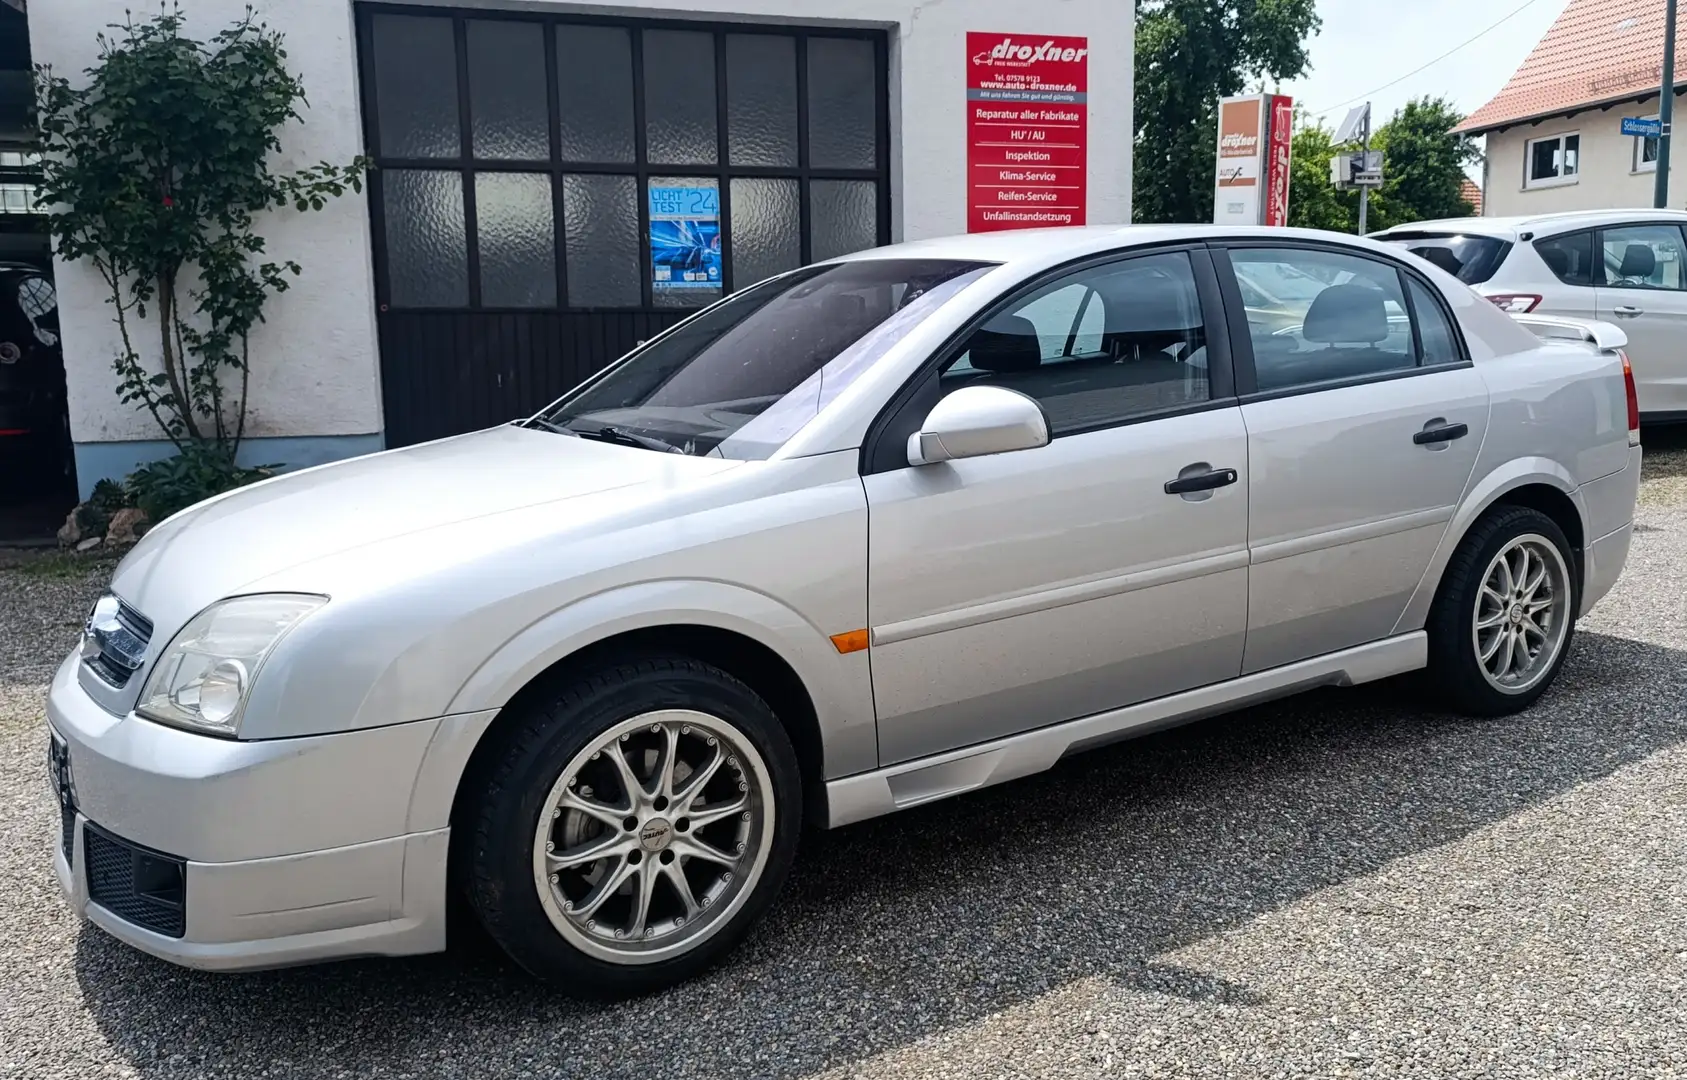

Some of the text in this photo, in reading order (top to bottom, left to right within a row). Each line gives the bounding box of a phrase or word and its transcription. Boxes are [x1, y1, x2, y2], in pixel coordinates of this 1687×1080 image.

[992, 38, 1088, 63] droxner
[994, 74, 1040, 83] Tel. 07578 9123
[976, 108, 1079, 122] Reparatur aller Fabrikate
[1032, 131, 1045, 140] AU
[1006, 151, 1050, 162] Inspektion
[1000, 170, 1056, 182] Klima-Service
[651, 190, 682, 200] LICHT
[998, 191, 1058, 202] Reifen-Service
[653, 201, 683, 212] TEST
[983, 211, 1072, 223] Unfallinstandsetzung
